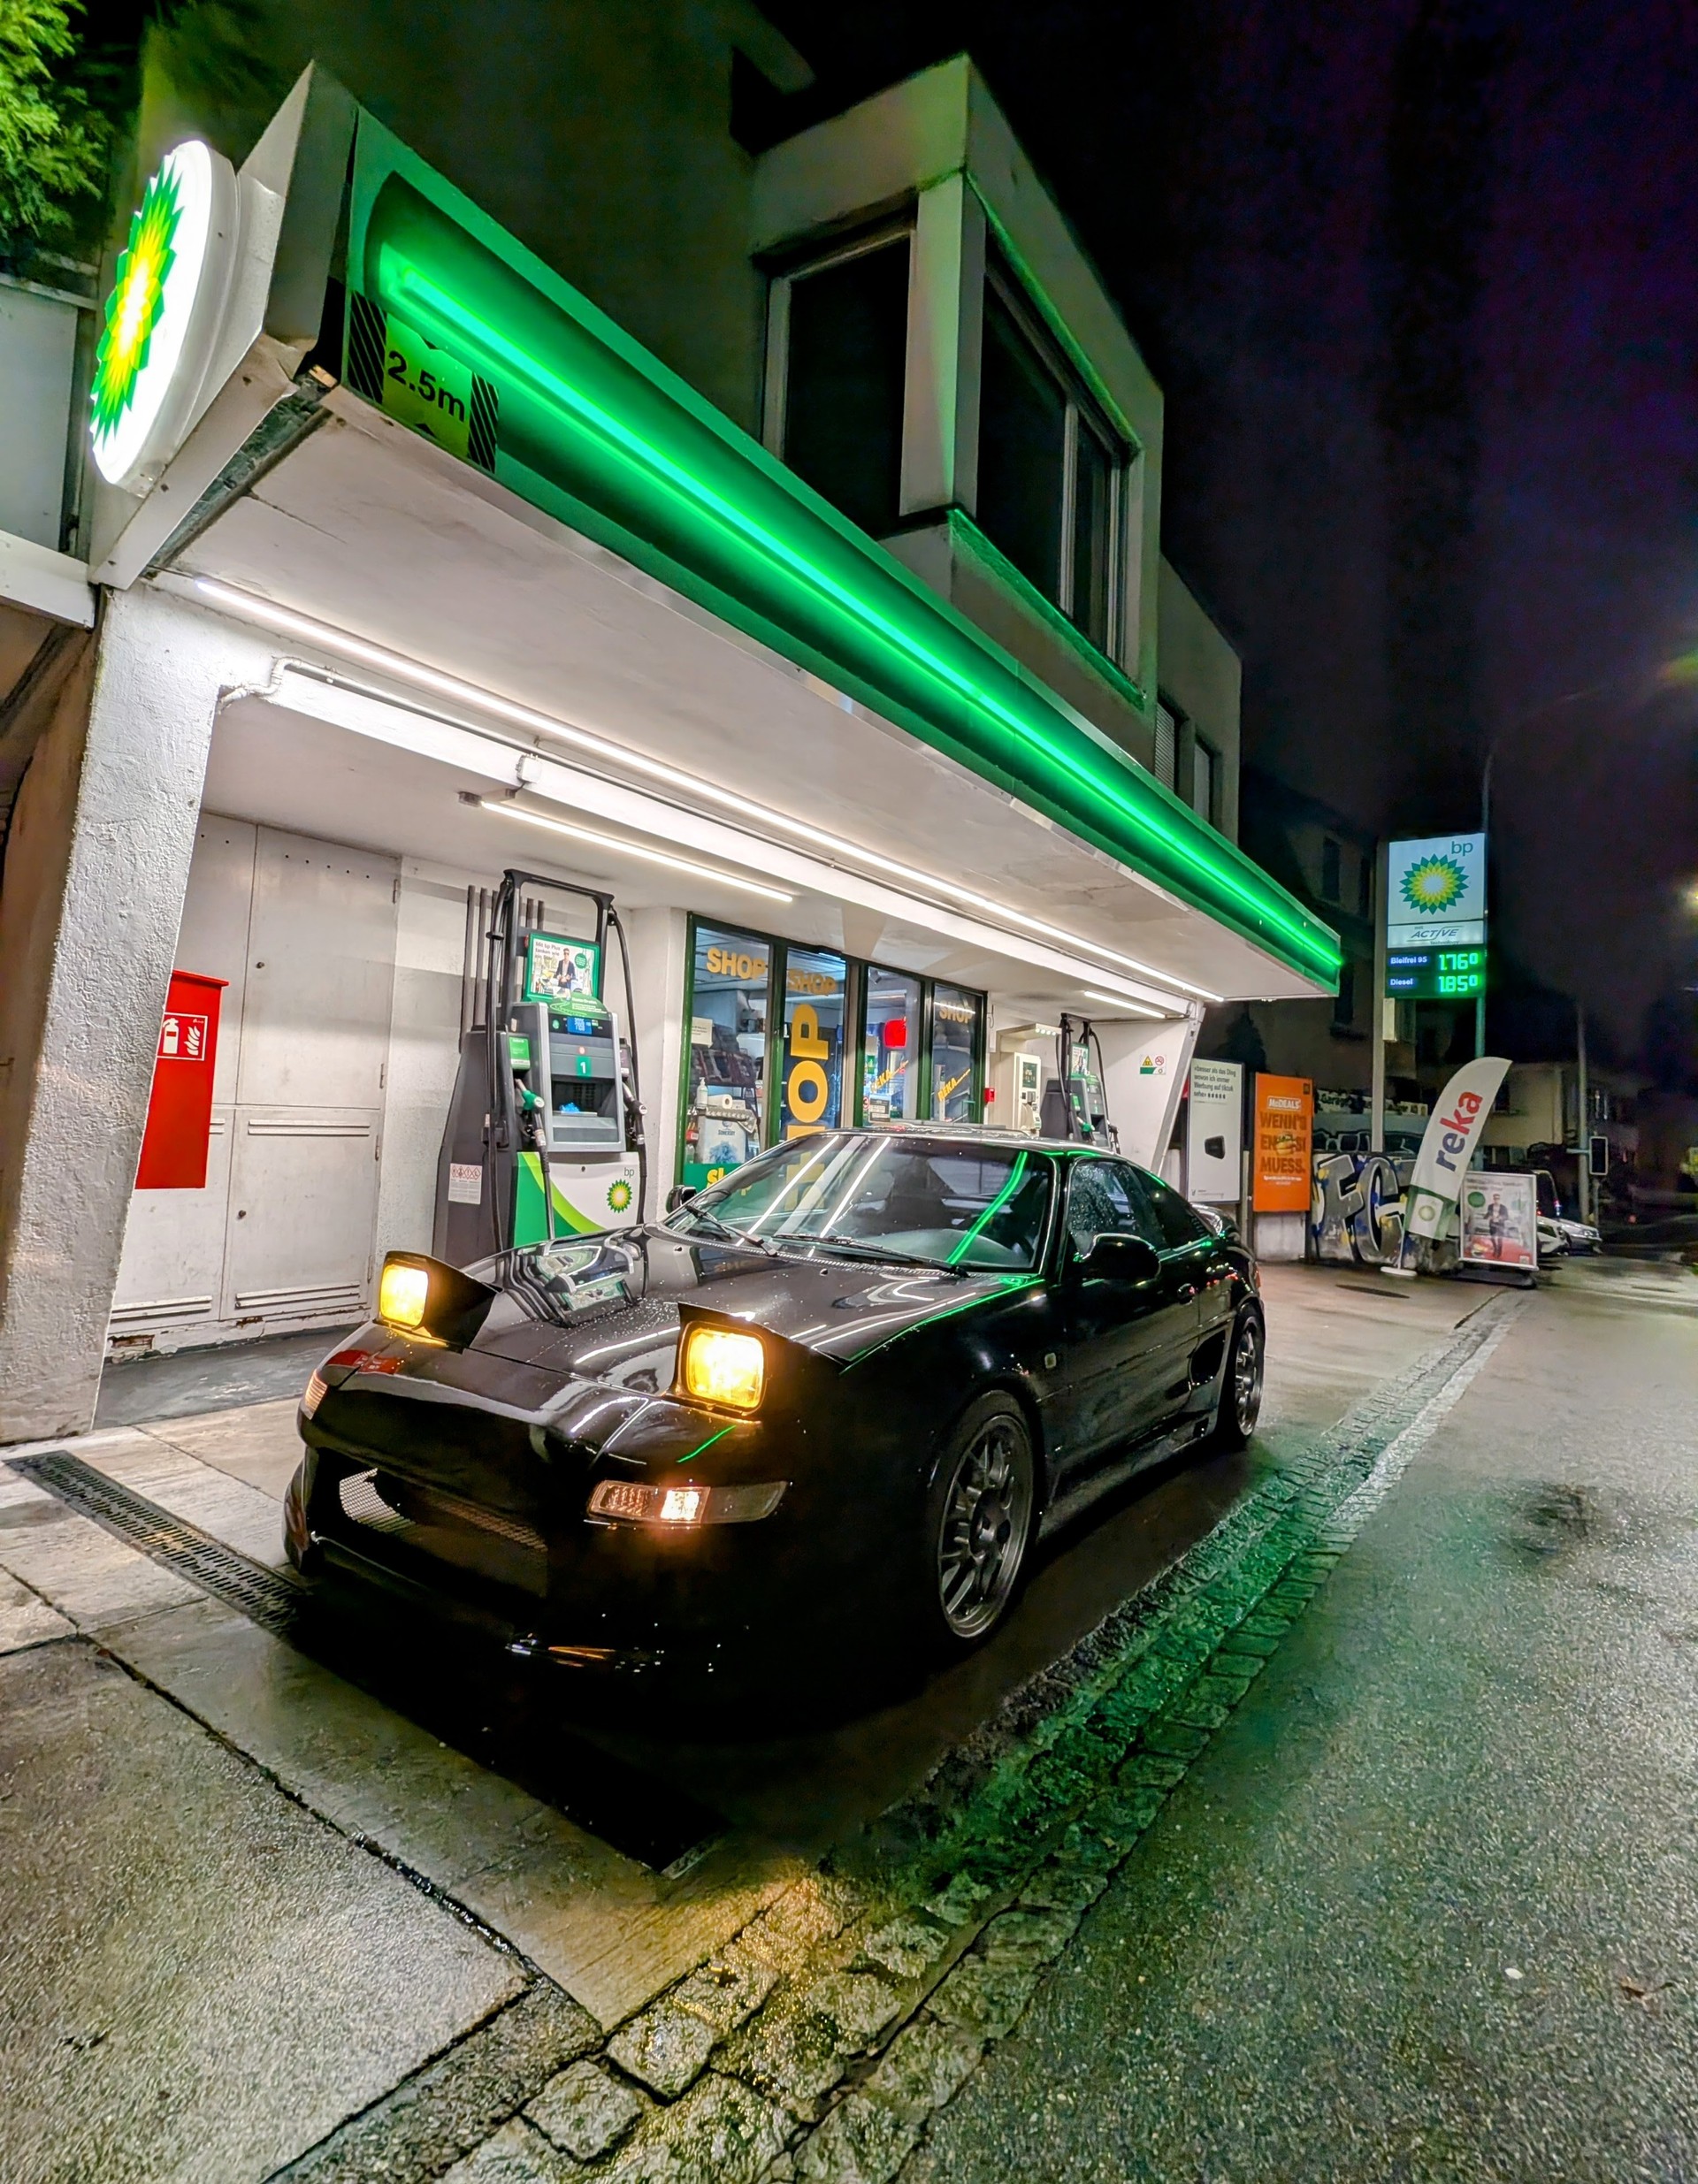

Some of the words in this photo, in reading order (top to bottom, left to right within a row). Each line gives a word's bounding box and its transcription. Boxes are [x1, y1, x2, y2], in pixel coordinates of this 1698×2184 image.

[387, 350, 465, 423] 2.5m
[1451, 840, 1473, 857] bp
[1409, 928, 1460, 940] ACTIVE
[707, 947, 766, 981] SHOP
[787, 968, 838, 996] SHOP
[580, 1061, 586, 1074] 1
[1435, 1091, 1483, 1172] reka
[623, 1167, 635, 1179] bp
